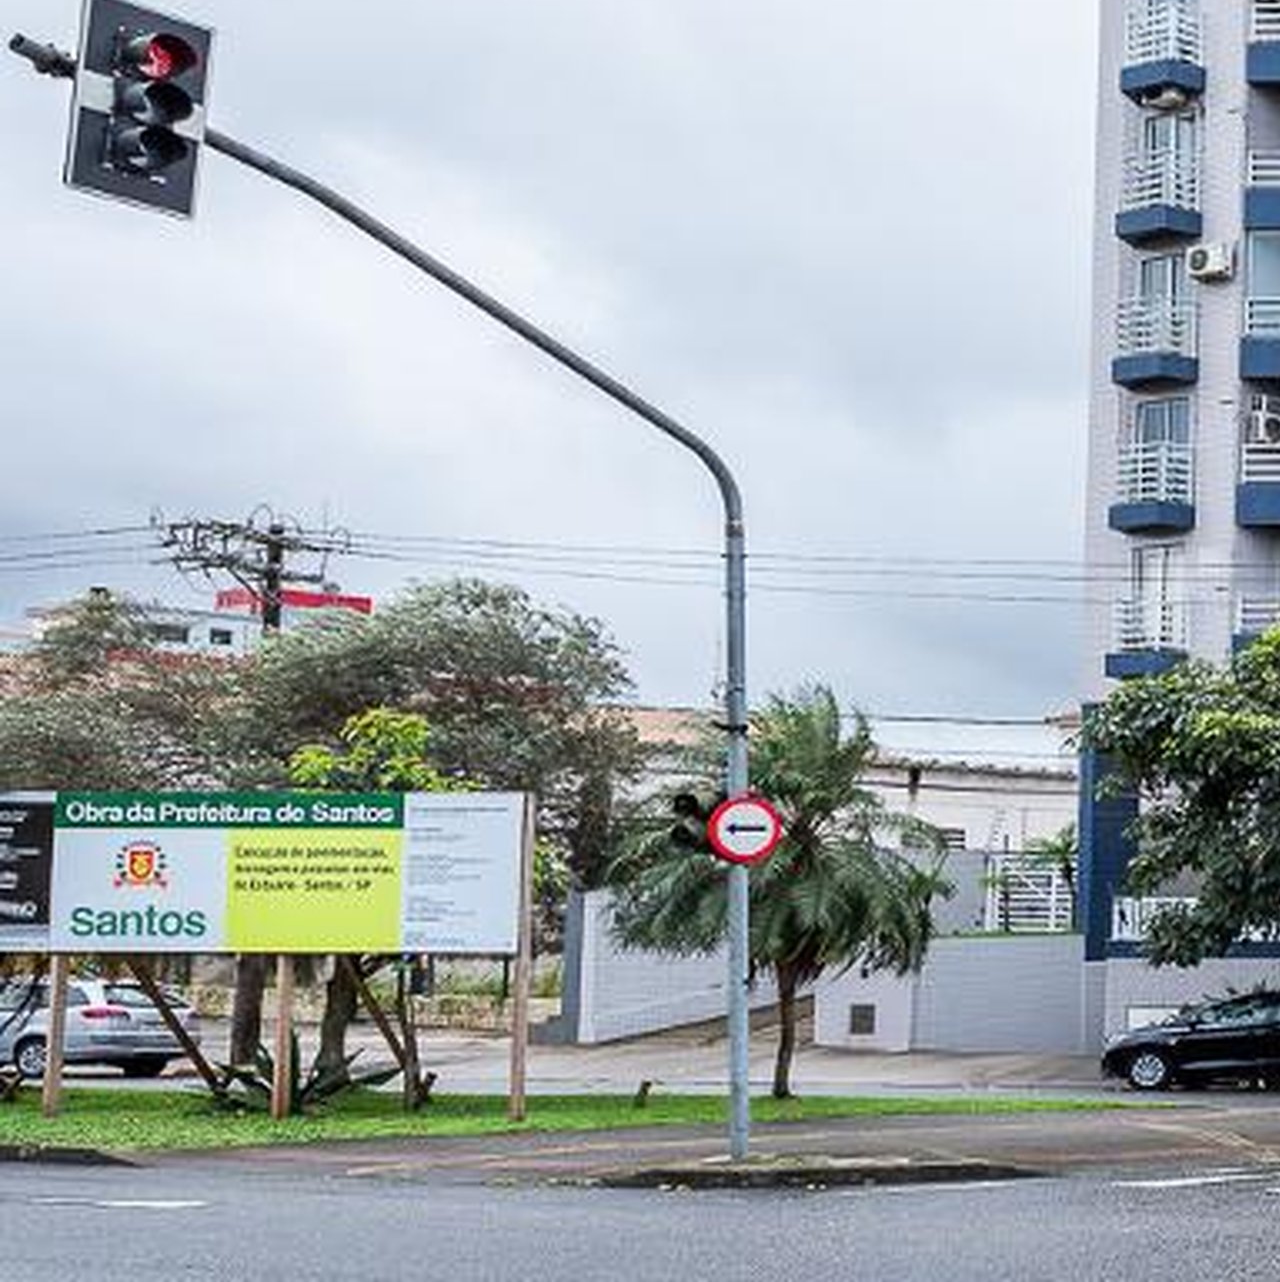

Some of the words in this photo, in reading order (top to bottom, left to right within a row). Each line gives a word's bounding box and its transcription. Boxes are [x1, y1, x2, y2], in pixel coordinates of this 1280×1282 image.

[66, 801, 123, 822] Obra
[127, 801, 155, 822] da
[159, 802, 271, 822] Prefeitura
[312, 801, 395, 823] Santos
[70, 905, 206, 936] Santos
